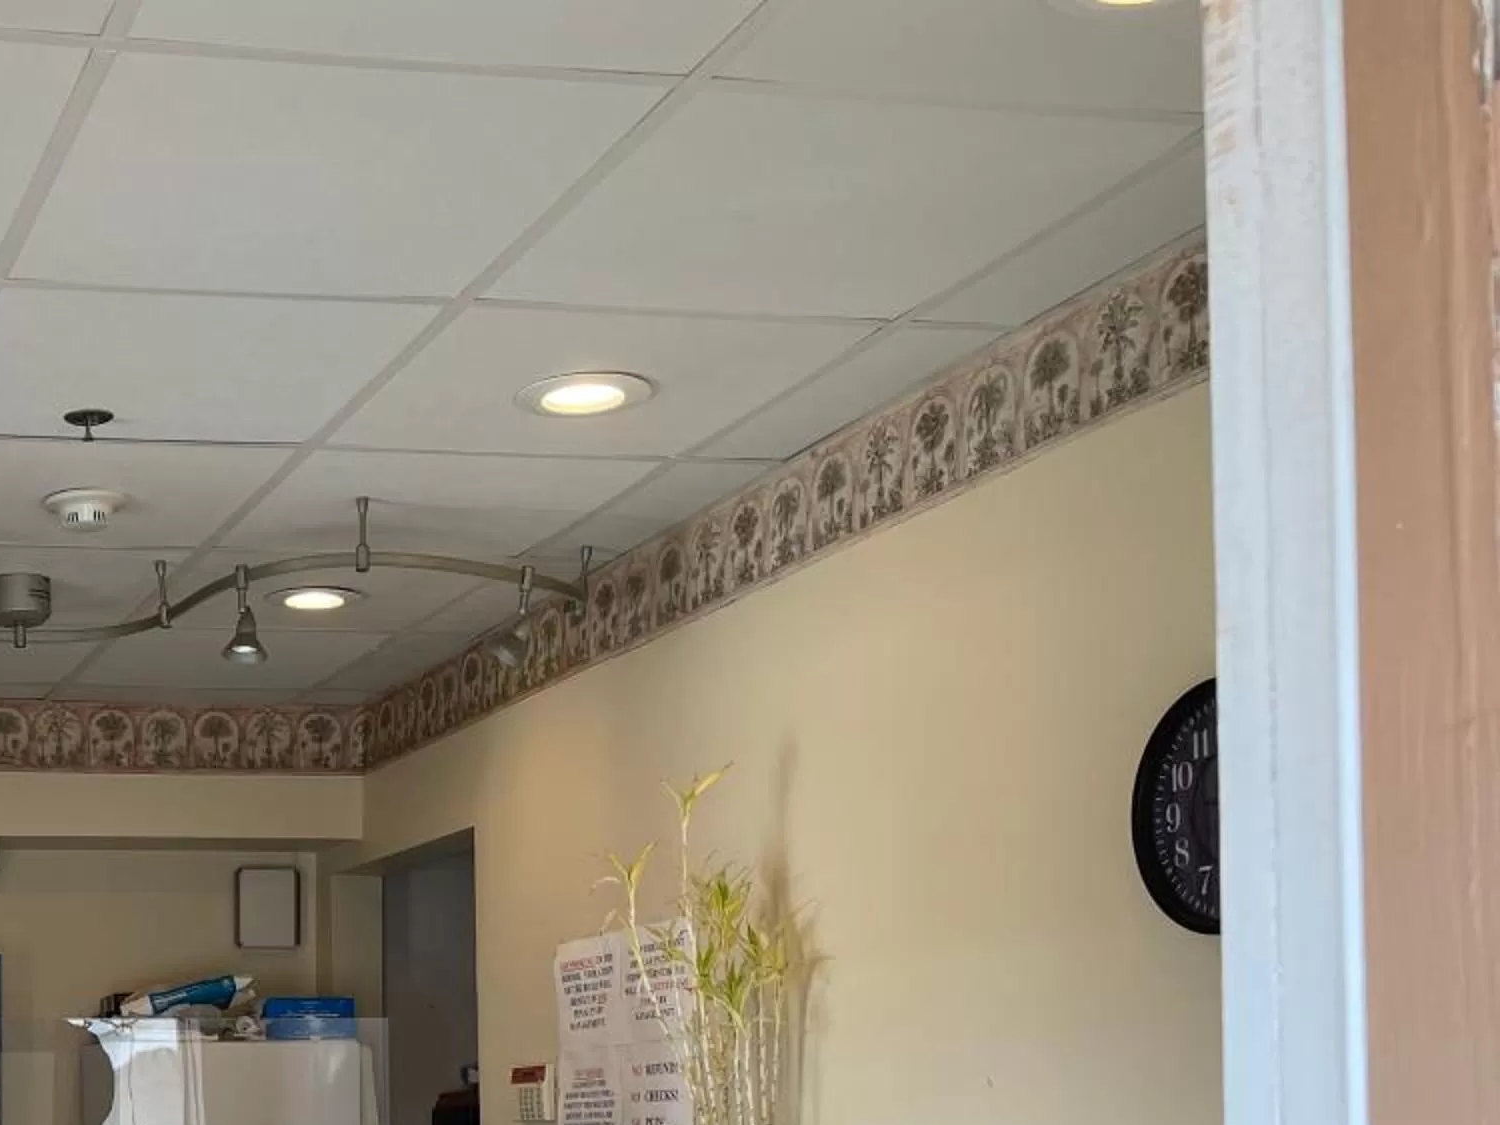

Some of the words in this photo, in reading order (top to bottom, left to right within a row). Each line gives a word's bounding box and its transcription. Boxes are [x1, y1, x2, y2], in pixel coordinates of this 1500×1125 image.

[1192, 727, 1211, 760] 11
[1171, 761, 1193, 792] 10
[1165, 803, 1181, 833] 9
[1174, 840, 1189, 868] 8
[1198, 865, 1213, 895] 7
